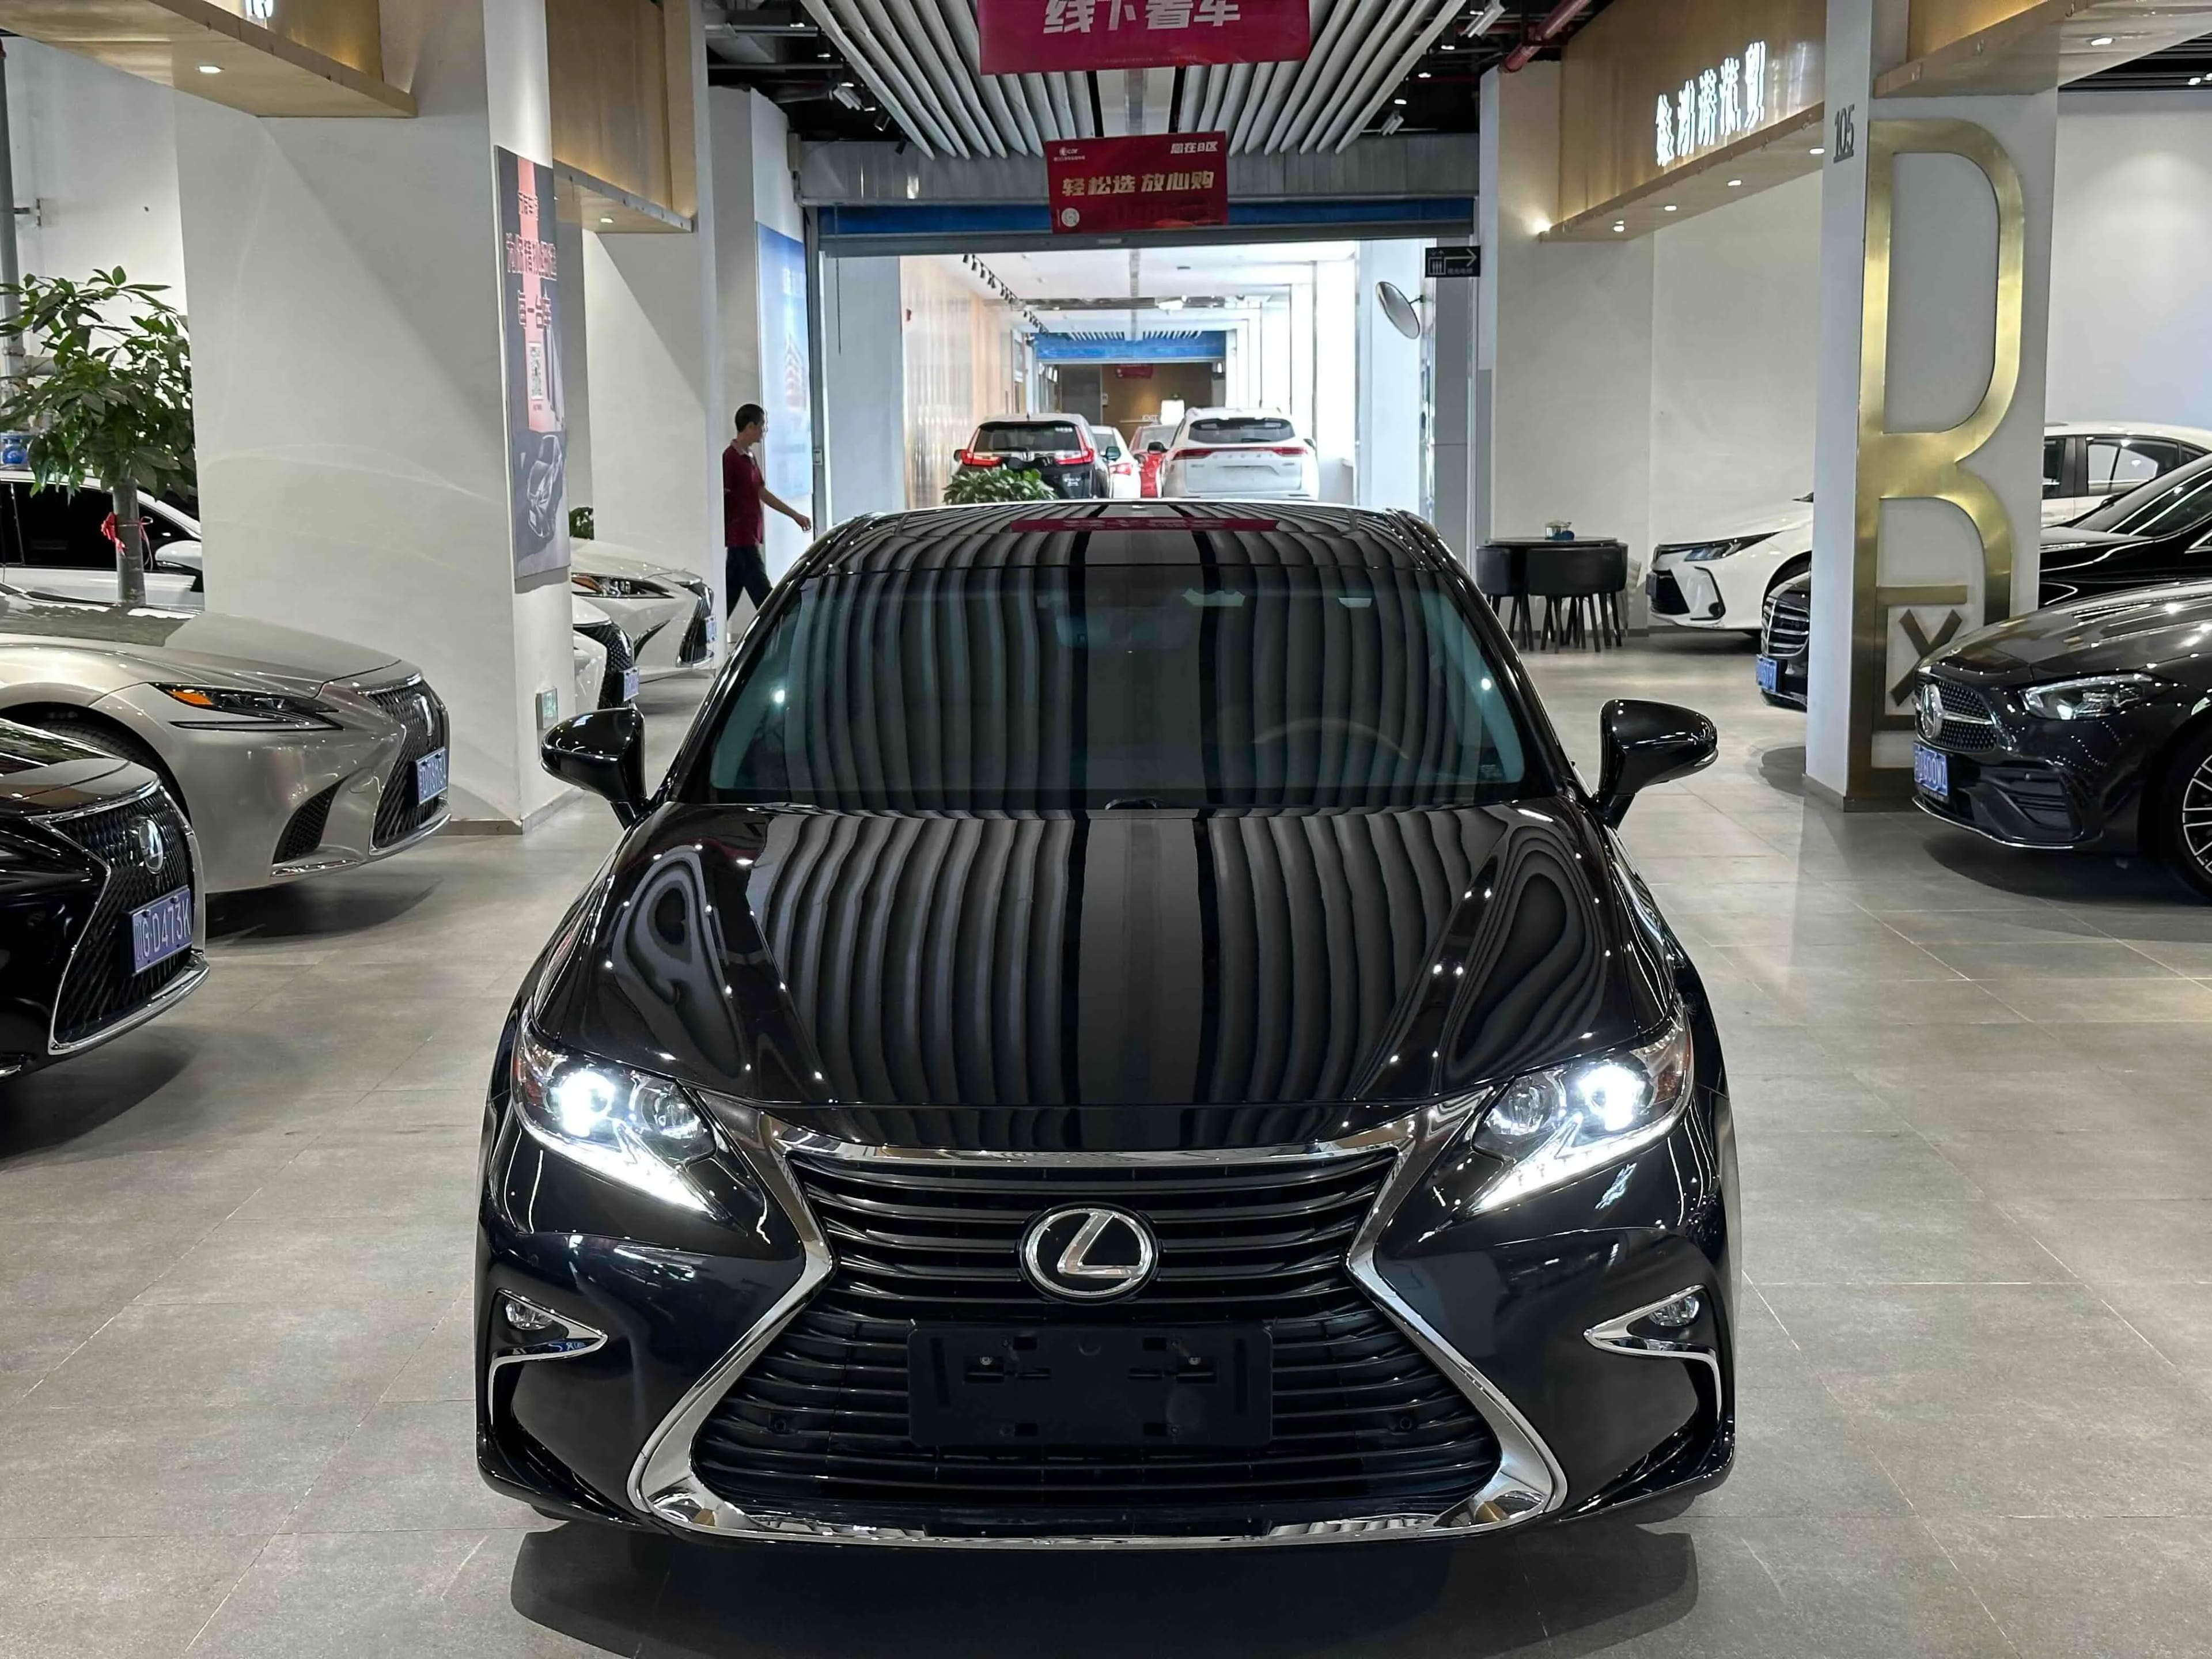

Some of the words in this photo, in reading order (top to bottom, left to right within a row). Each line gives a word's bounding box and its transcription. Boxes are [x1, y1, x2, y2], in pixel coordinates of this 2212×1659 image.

[1834, 104, 1855, 163] 105
[1062, 175, 1135, 196] 轻松选
[1141, 171, 1214, 192] 放心购
